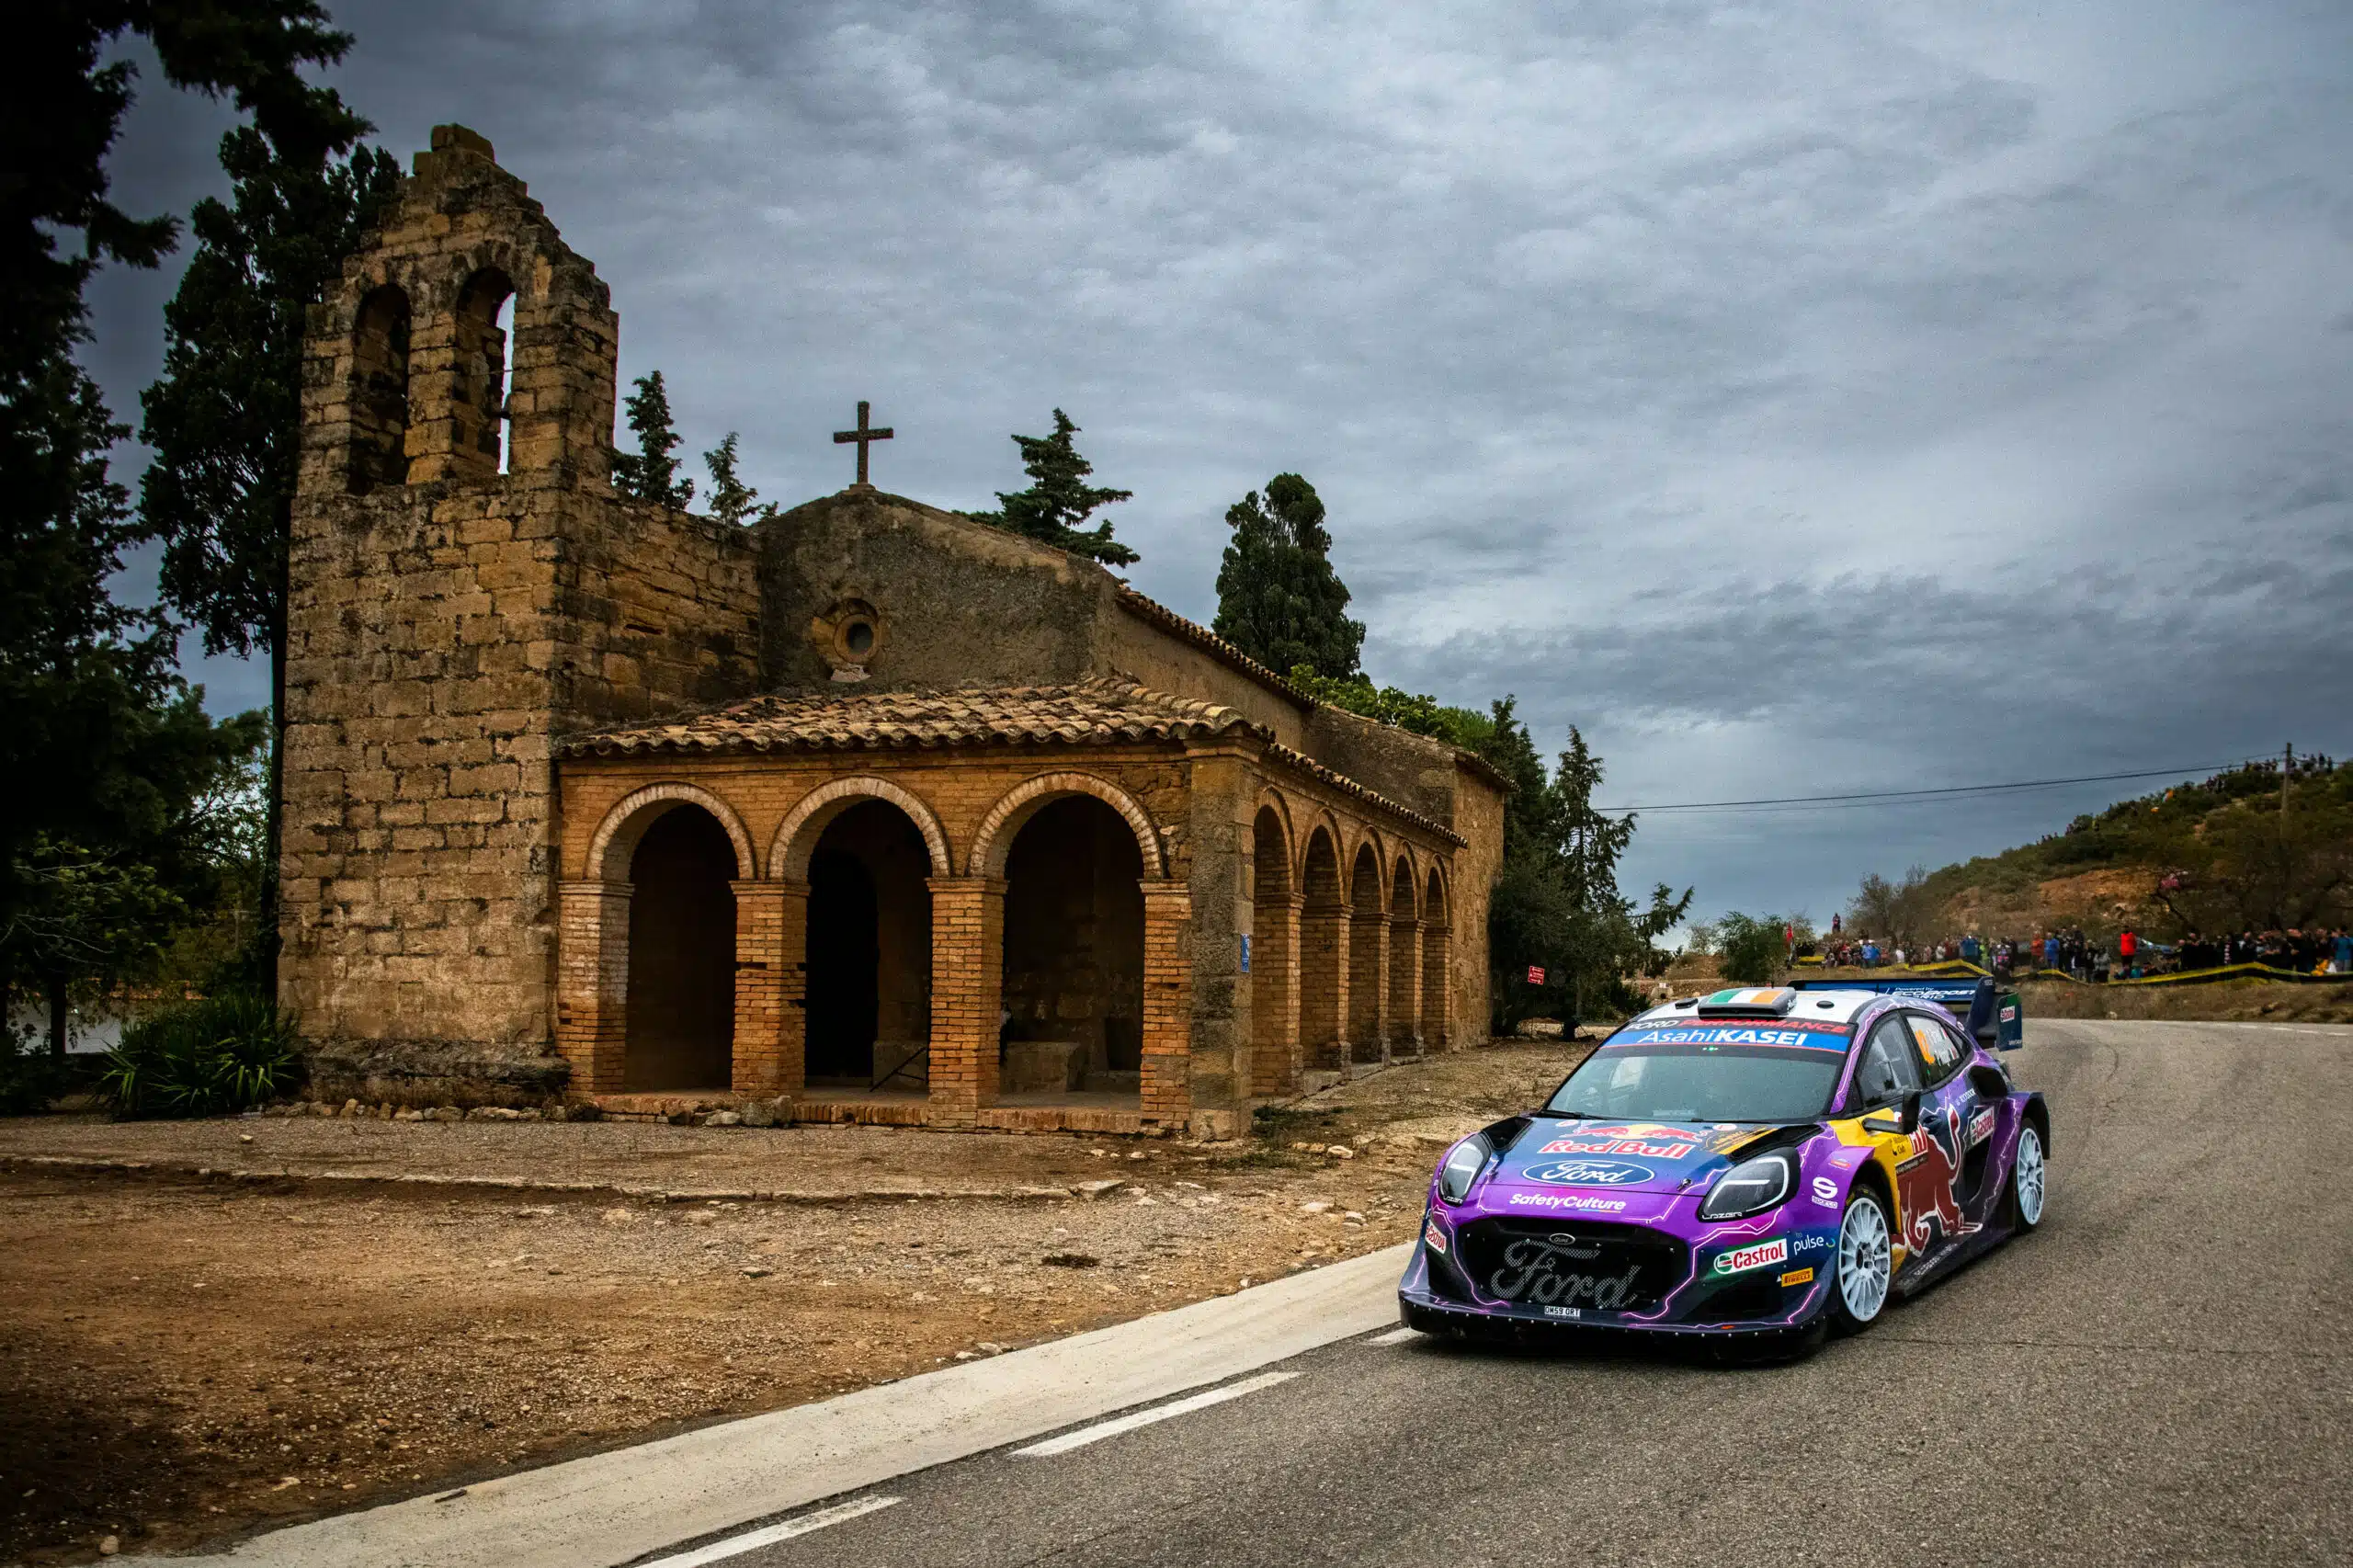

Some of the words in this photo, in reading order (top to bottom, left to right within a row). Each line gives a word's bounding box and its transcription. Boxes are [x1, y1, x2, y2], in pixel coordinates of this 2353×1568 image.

[1625, 1019, 1679, 1031] FORD
[1678, 1017, 1850, 1034] PERFORMANCE
[1636, 1028, 1809, 1046] AsahiKASEI
[1540, 1161, 1632, 1184] Ford
[1509, 1193, 1627, 1210] SafetyCulture
[1733, 1242, 1785, 1269] Castrol
[1793, 1234, 1824, 1256] pulse
[1490, 1239, 1643, 1310] Ford
